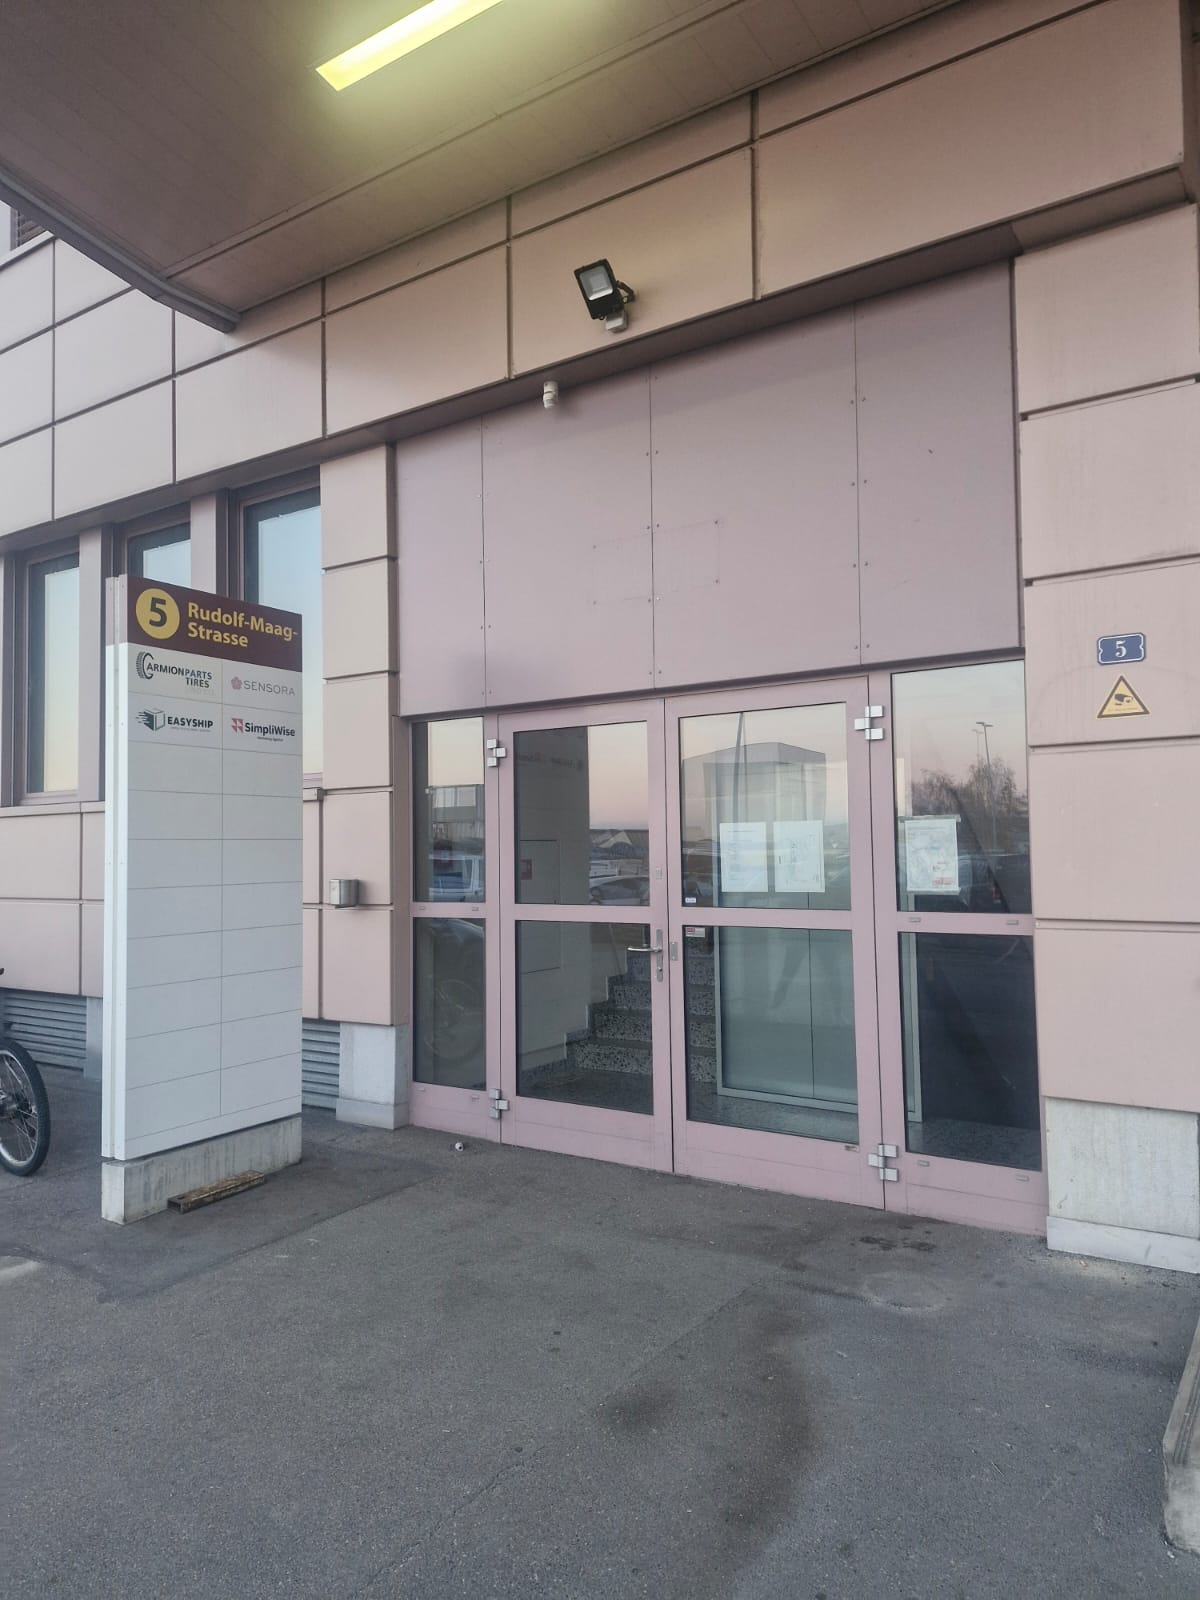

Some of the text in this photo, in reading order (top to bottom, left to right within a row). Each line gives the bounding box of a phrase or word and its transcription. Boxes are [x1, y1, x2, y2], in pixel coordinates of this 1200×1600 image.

[149, 597, 167, 627] 5
[188, 602, 298, 641] Rudolf-Maag-
[188, 622, 248, 647] Strasse
[1115, 640, 1127, 658] 5
[186, 677, 210, 688] TIRES
[243, 680, 295, 696] SENSORA
[167, 716, 214, 728] EASYSHIP
[245, 722, 295, 736] SimpliWise
